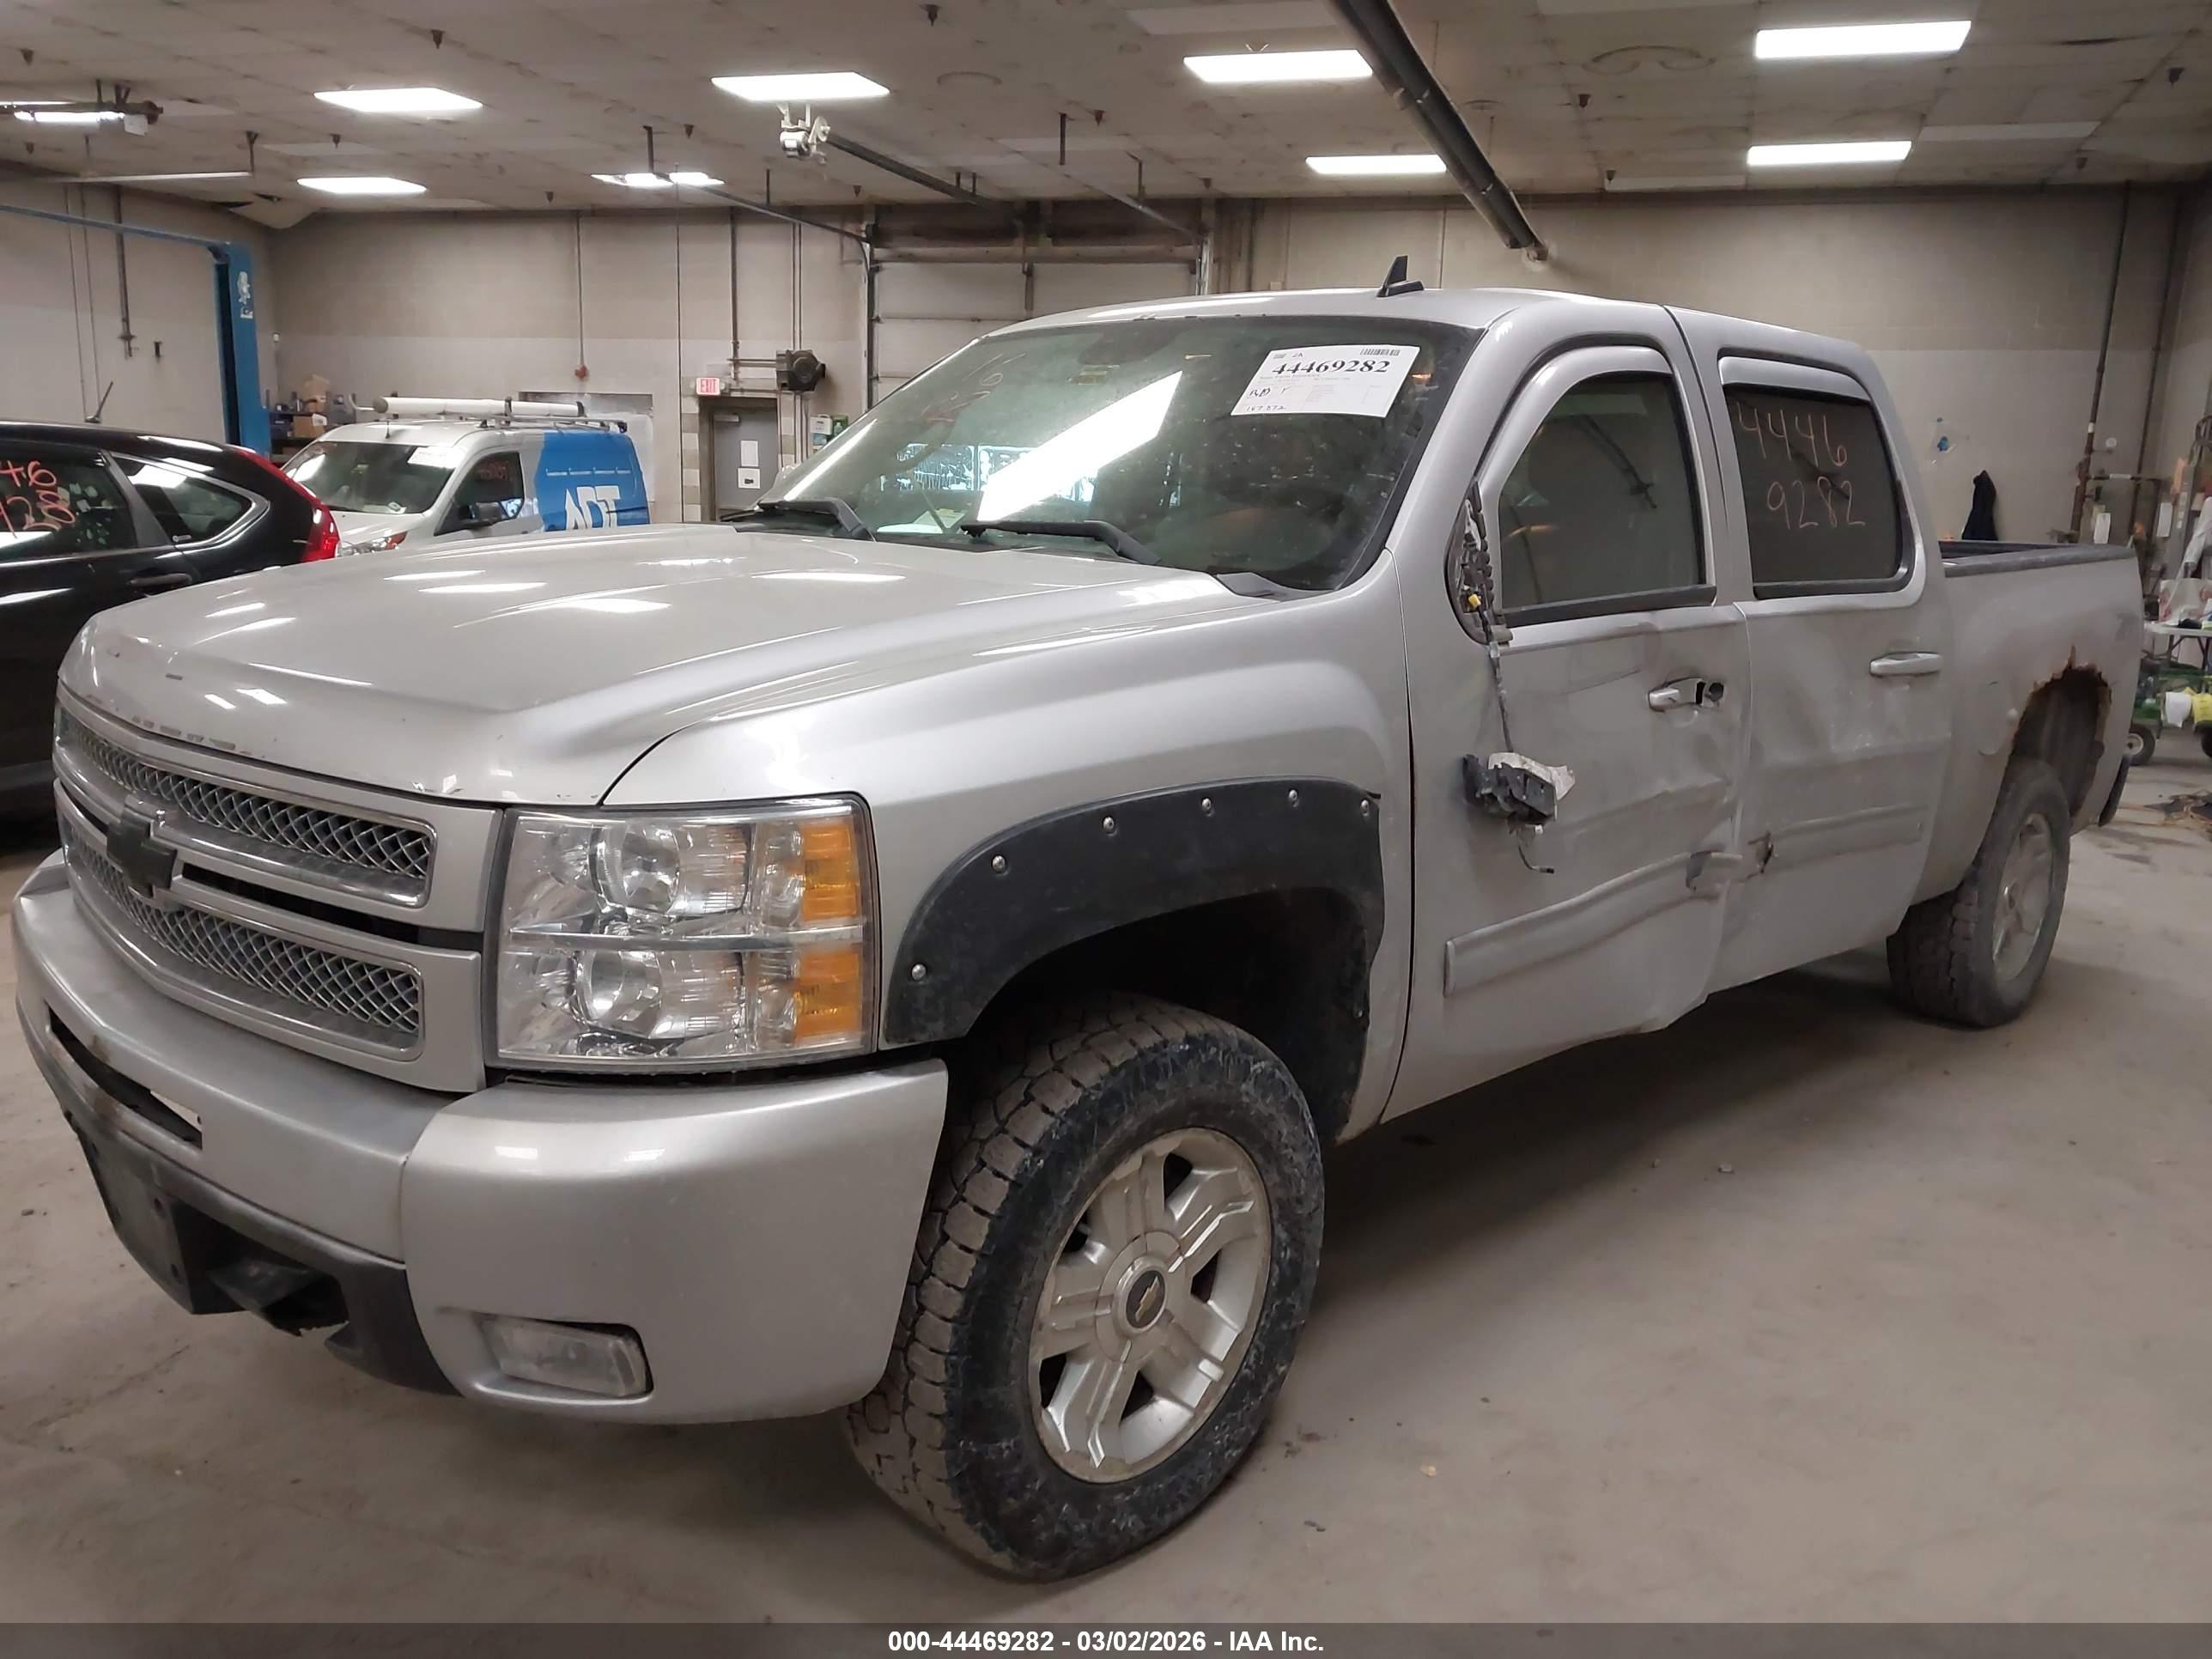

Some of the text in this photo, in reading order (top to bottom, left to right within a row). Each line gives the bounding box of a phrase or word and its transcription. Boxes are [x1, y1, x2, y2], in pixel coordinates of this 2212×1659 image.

[700, 379, 717, 393] EXIT
[1272, 359, 1391, 374] 44469282
[1736, 402, 1847, 467] 4446
[565, 485, 621, 530] ADT
[1766, 476, 1866, 529] 9282
